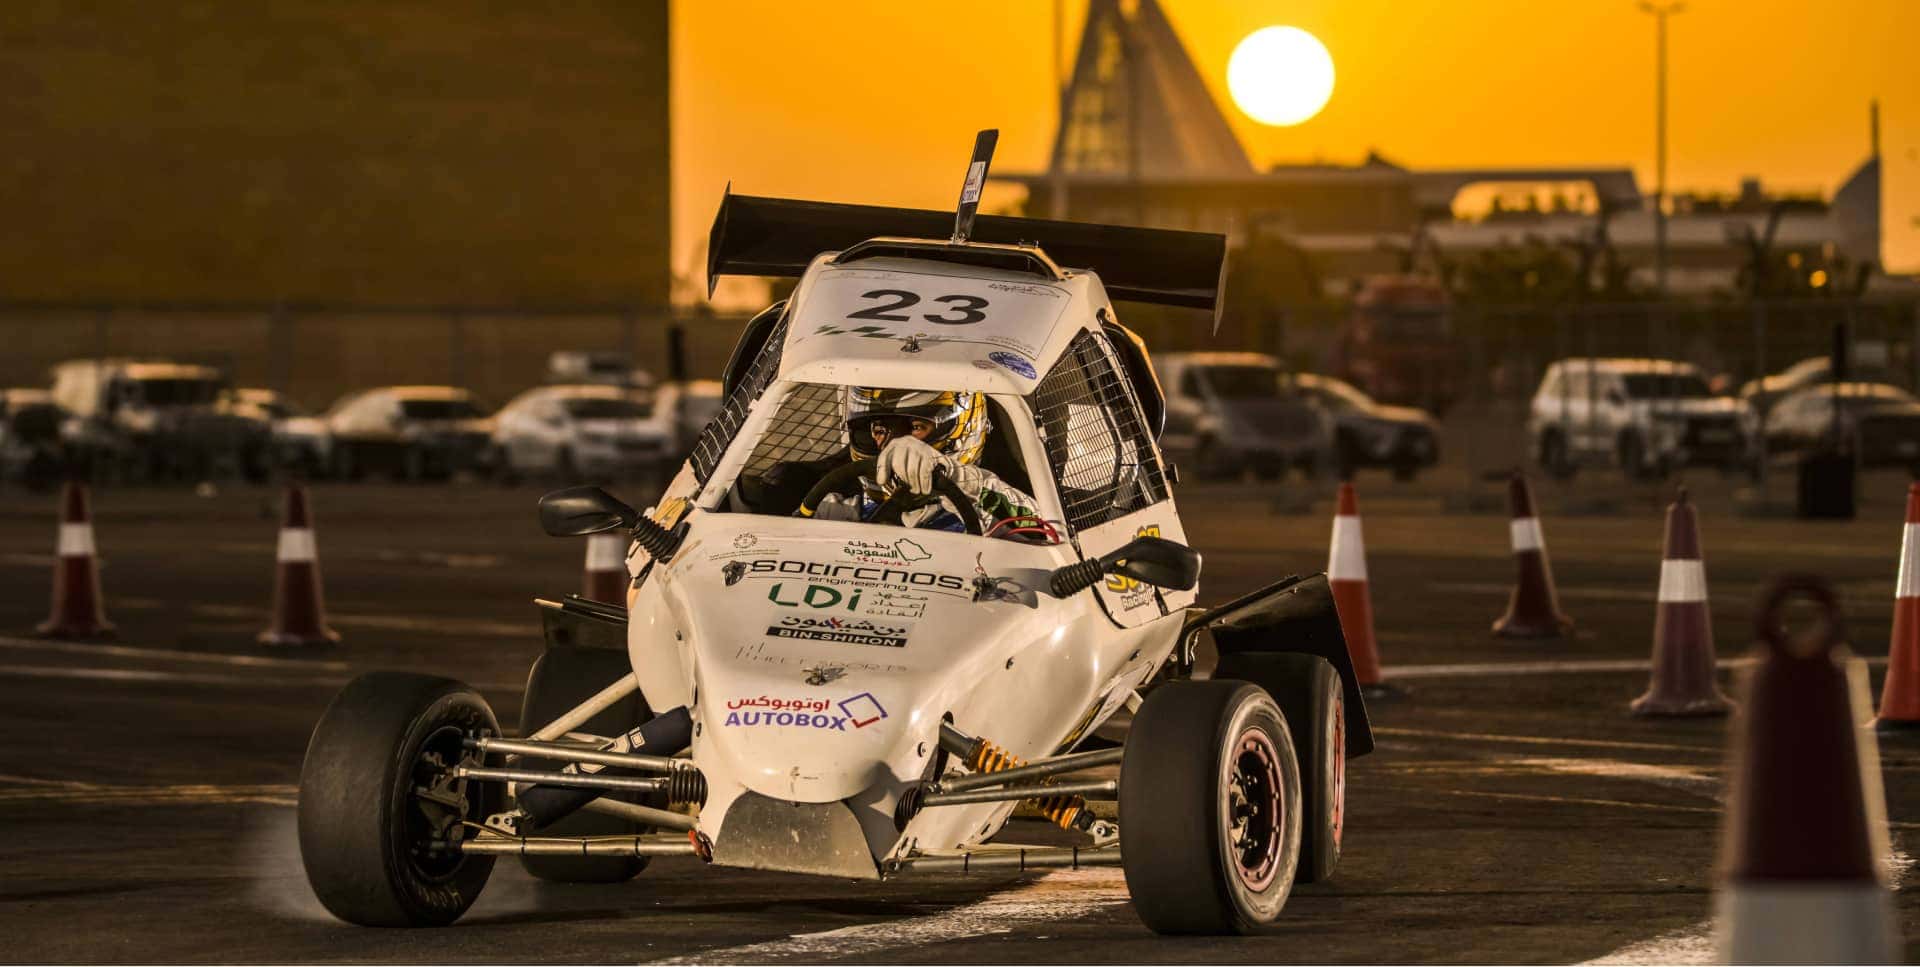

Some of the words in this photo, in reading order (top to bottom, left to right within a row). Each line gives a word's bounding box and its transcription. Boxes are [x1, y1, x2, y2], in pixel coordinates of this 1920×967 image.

[846, 289, 989, 325] 23
[843, 546, 898, 559] السعودية
[808, 575, 908, 592] engineering
[777, 629, 898, 647] BIN-SHIHON
[724, 712, 848, 731] AUTOBOX
